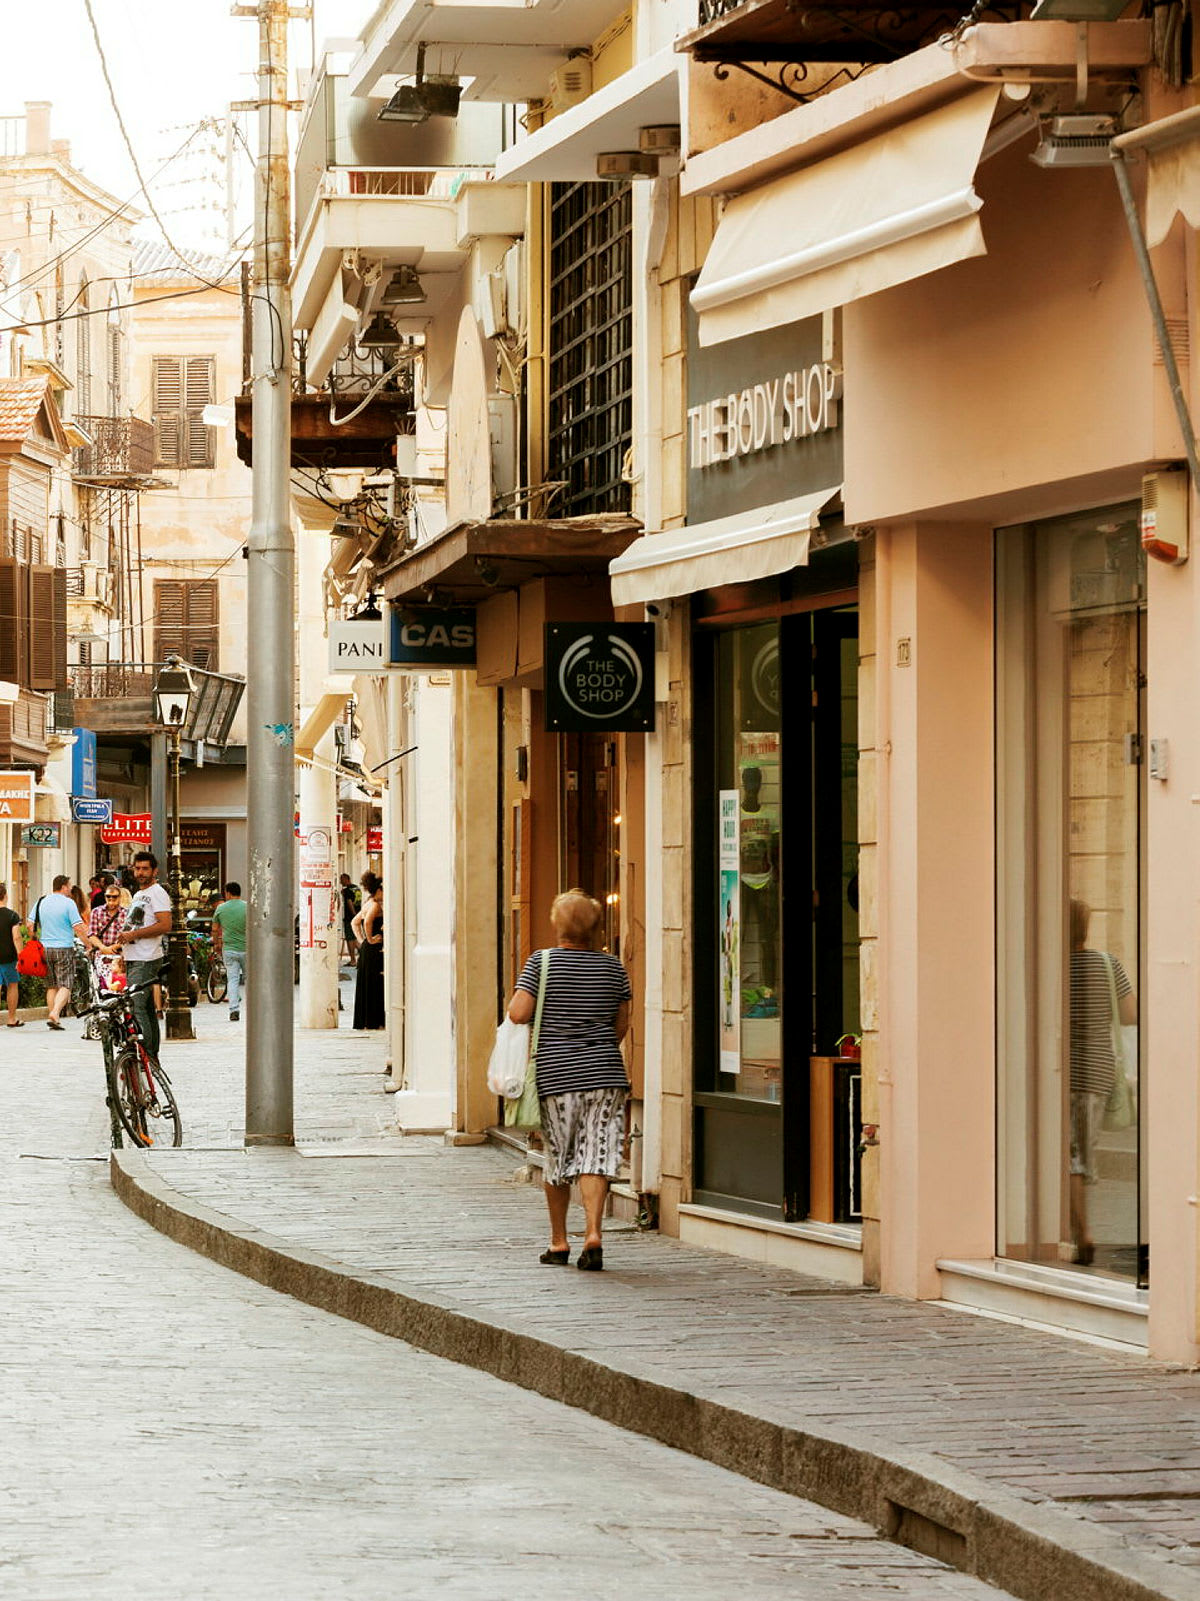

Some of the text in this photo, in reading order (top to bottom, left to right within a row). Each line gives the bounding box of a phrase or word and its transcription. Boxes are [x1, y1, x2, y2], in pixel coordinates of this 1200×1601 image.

[688, 363, 835, 468] THE BODY SHOP
[401, 624, 474, 648] CAS
[586, 660, 615, 672] THE
[576, 673, 627, 688] BODY
[579, 689, 624, 702] SHOP
[29, 827, 53, 842] K22
